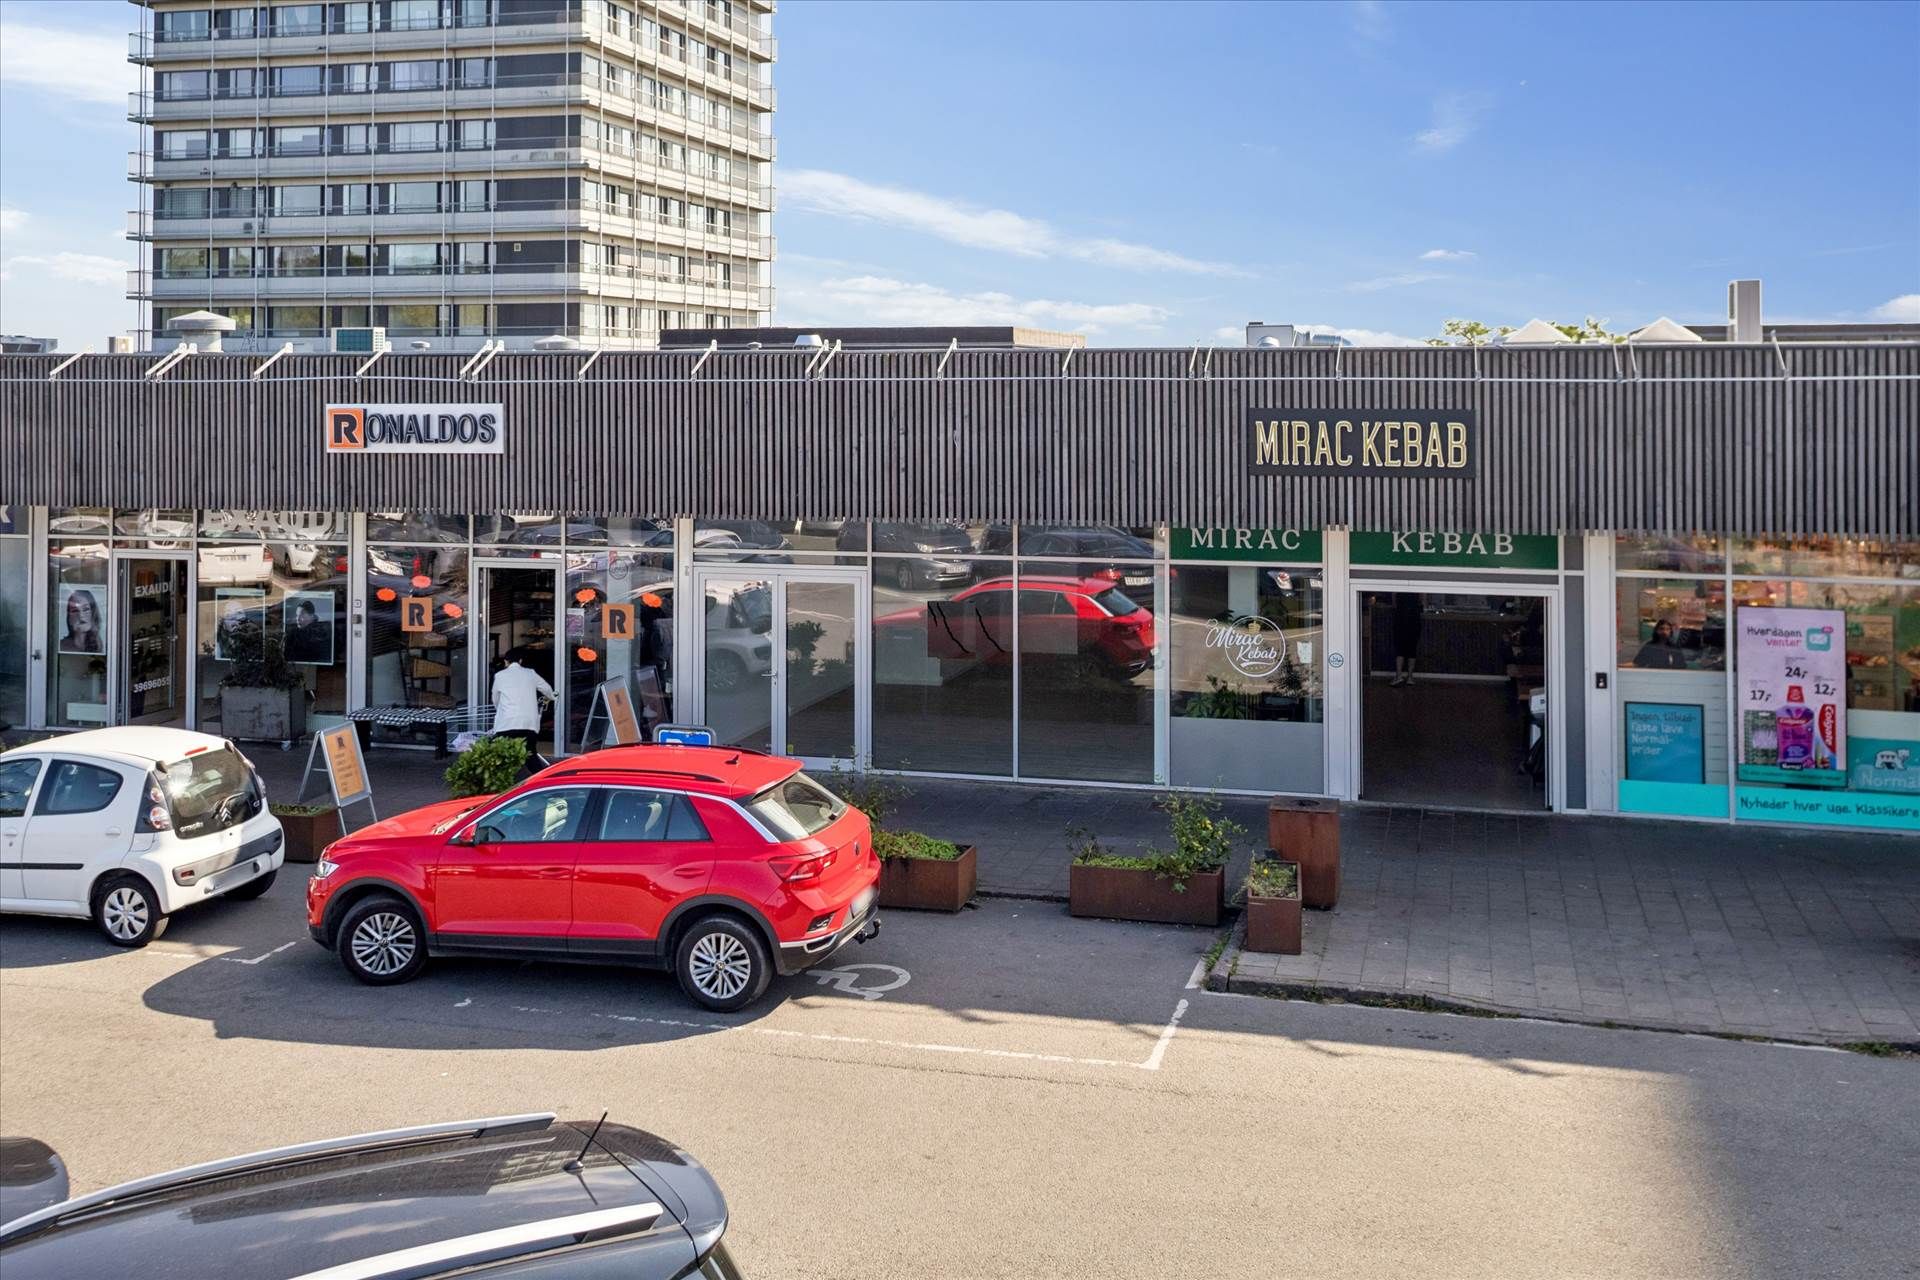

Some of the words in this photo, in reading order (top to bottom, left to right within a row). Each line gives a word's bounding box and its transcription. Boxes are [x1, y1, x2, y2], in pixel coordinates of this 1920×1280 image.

[333, 412, 497, 445] RONALDOS
[1255, 420, 1353, 467] MIRAC
[1362, 421, 1467, 468] KEBAB
[1190, 528, 1300, 550] MIRAC
[1391, 531, 1514, 555] KEBAB
[409, 602, 425, 627] R
[609, 609, 626, 634] R
[1205, 618, 1264, 648] Mirac
[1747, 626, 1802, 638] Hverdagen
[1236, 646, 1277, 661] Kebab
[1740, 796, 1788, 812] Nyheder
[1793, 799, 1822, 812] hver
[1827, 804, 1851, 815] uge.
[1856, 803, 1919, 818] Klassikere
